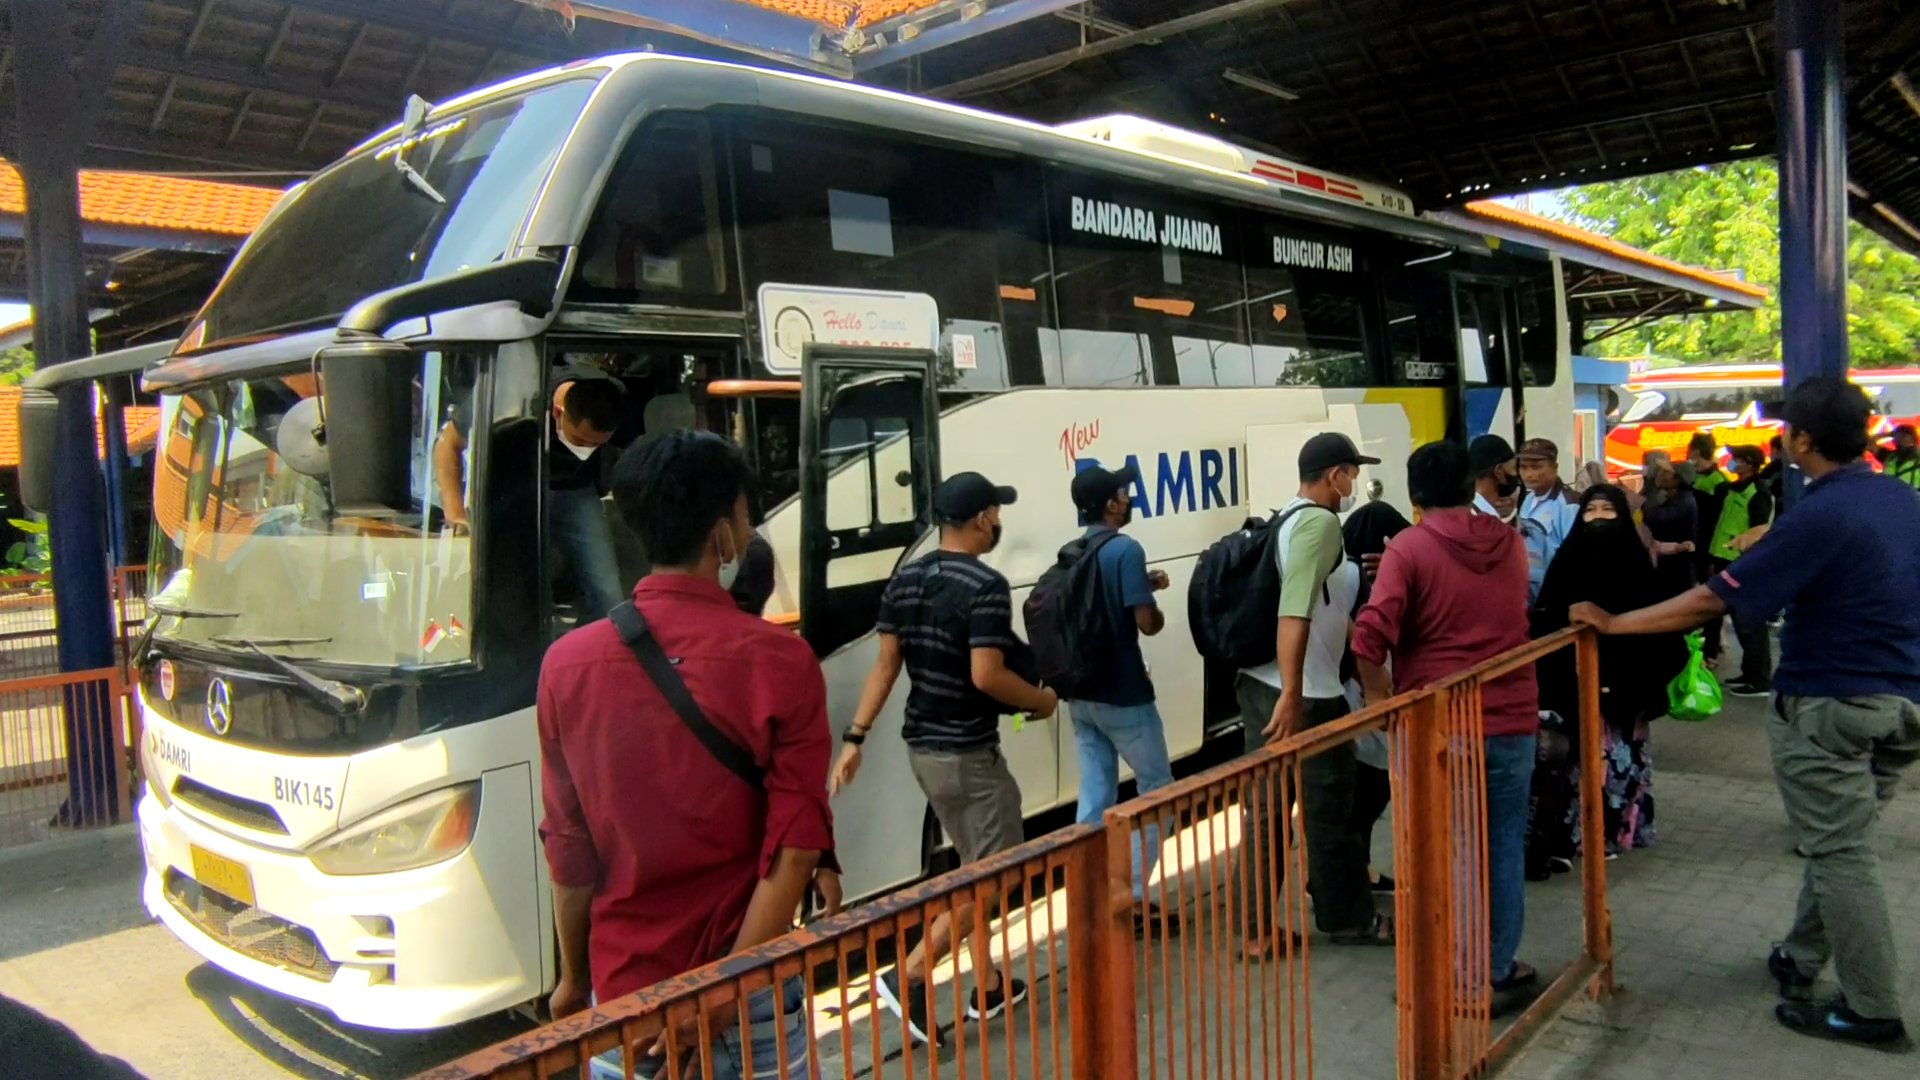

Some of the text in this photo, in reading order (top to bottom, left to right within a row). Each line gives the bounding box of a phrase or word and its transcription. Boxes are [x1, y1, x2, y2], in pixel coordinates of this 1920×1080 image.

[1071, 196, 1222, 255] BANDARA JUANDA
[1273, 236, 1353, 273] BUNGUR ASIH
[823, 310, 862, 330] Hello
[1059, 418, 1099, 471] New
[160, 737, 191, 773] DAMRI
[274, 776, 334, 811] BIK145
